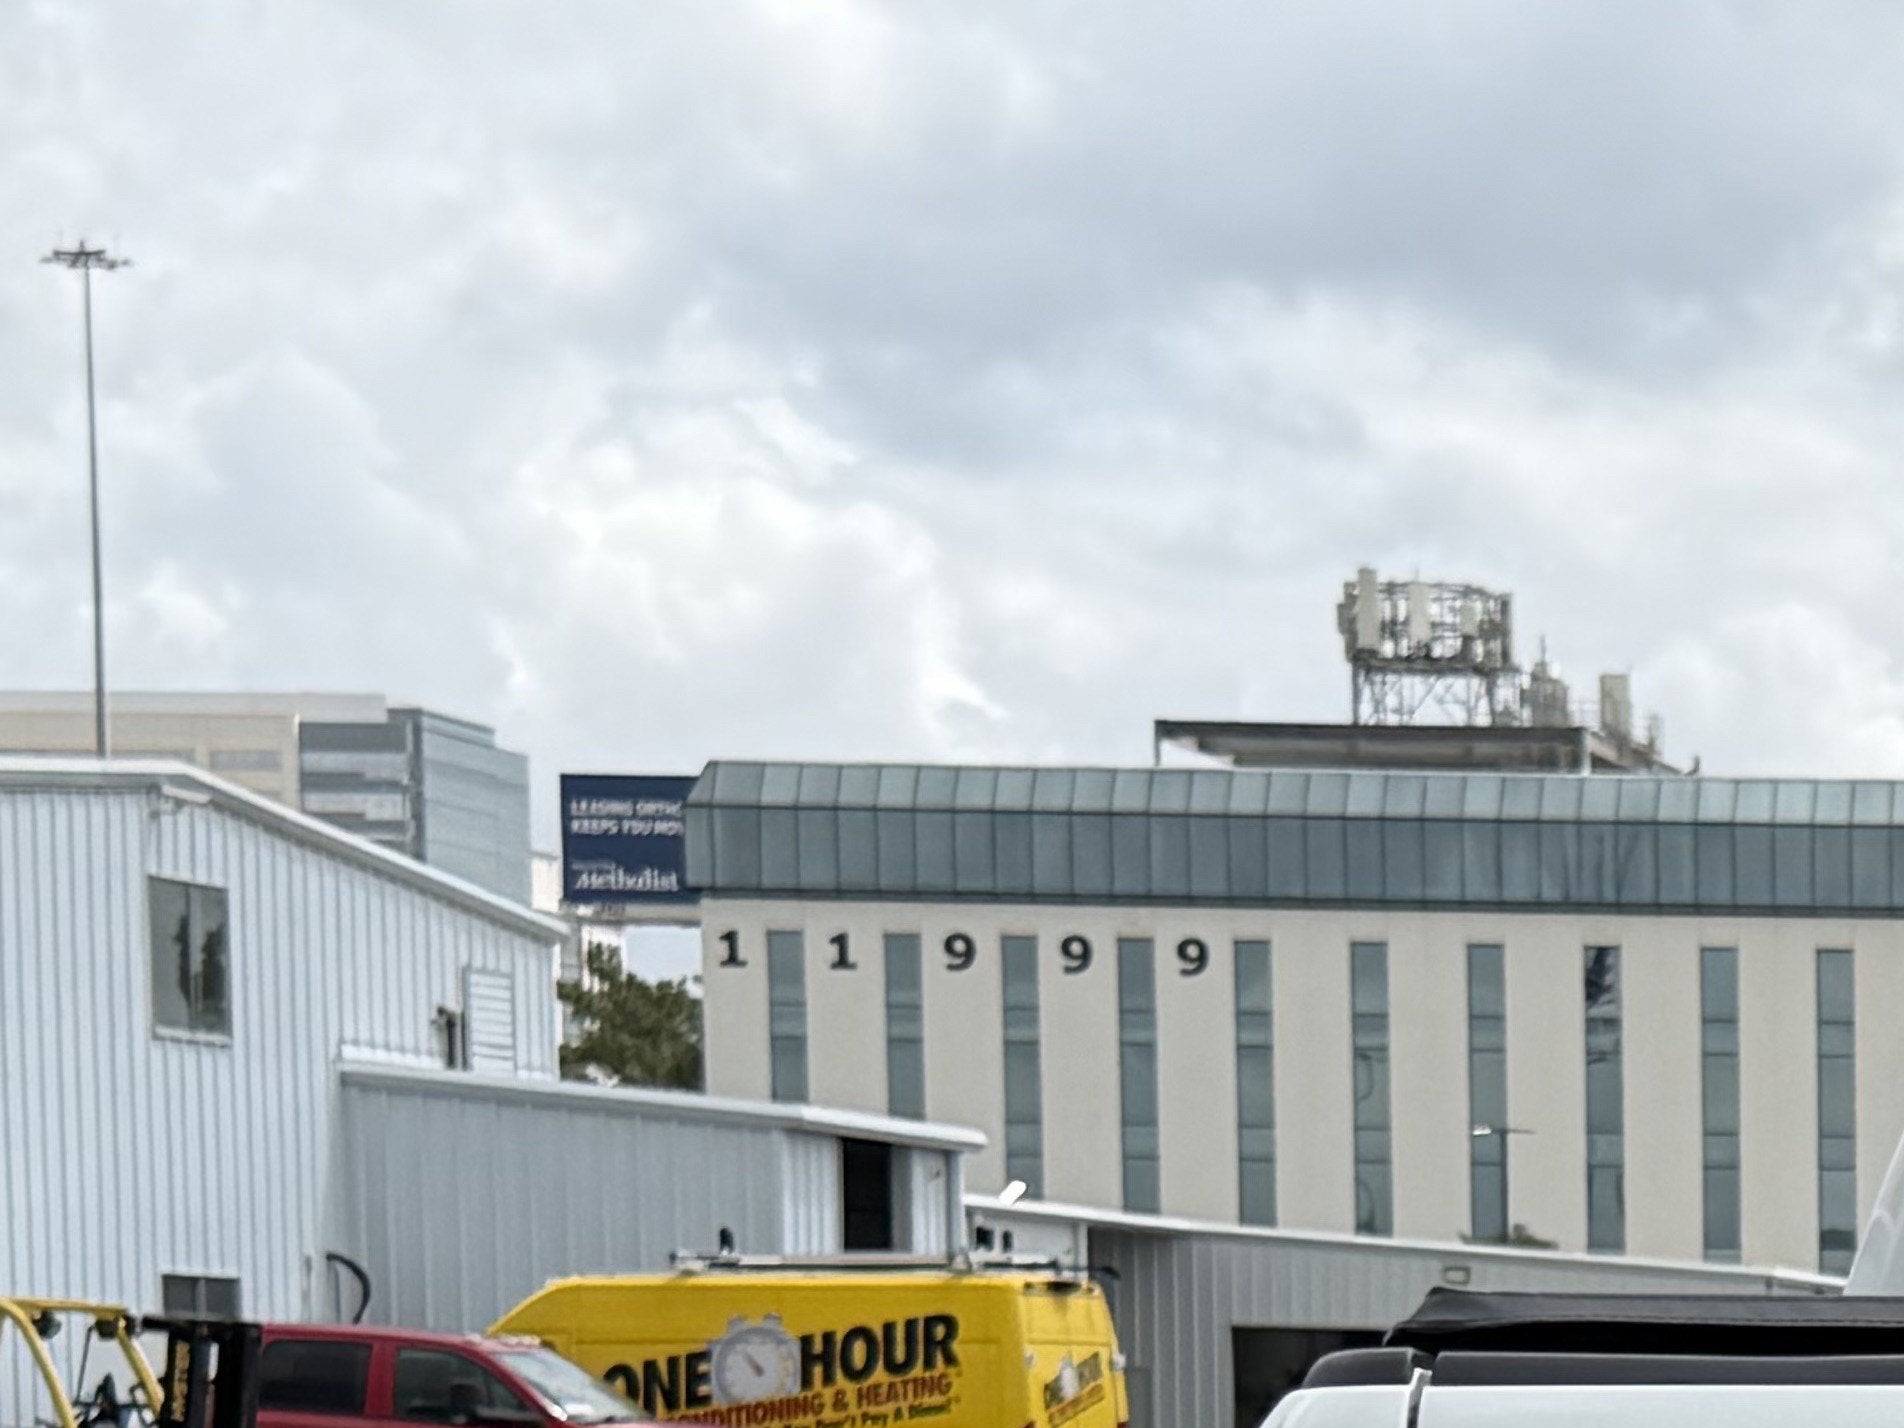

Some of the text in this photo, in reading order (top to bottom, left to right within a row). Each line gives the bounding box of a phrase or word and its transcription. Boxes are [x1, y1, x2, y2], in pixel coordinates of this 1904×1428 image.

[575, 867, 679, 891] Methodist
[602, 1349, 713, 1422] ONE
[799, 1313, 960, 1393] HOUR
[832, 1387, 850, 1413] &
[856, 1371, 953, 1410] HEATING
